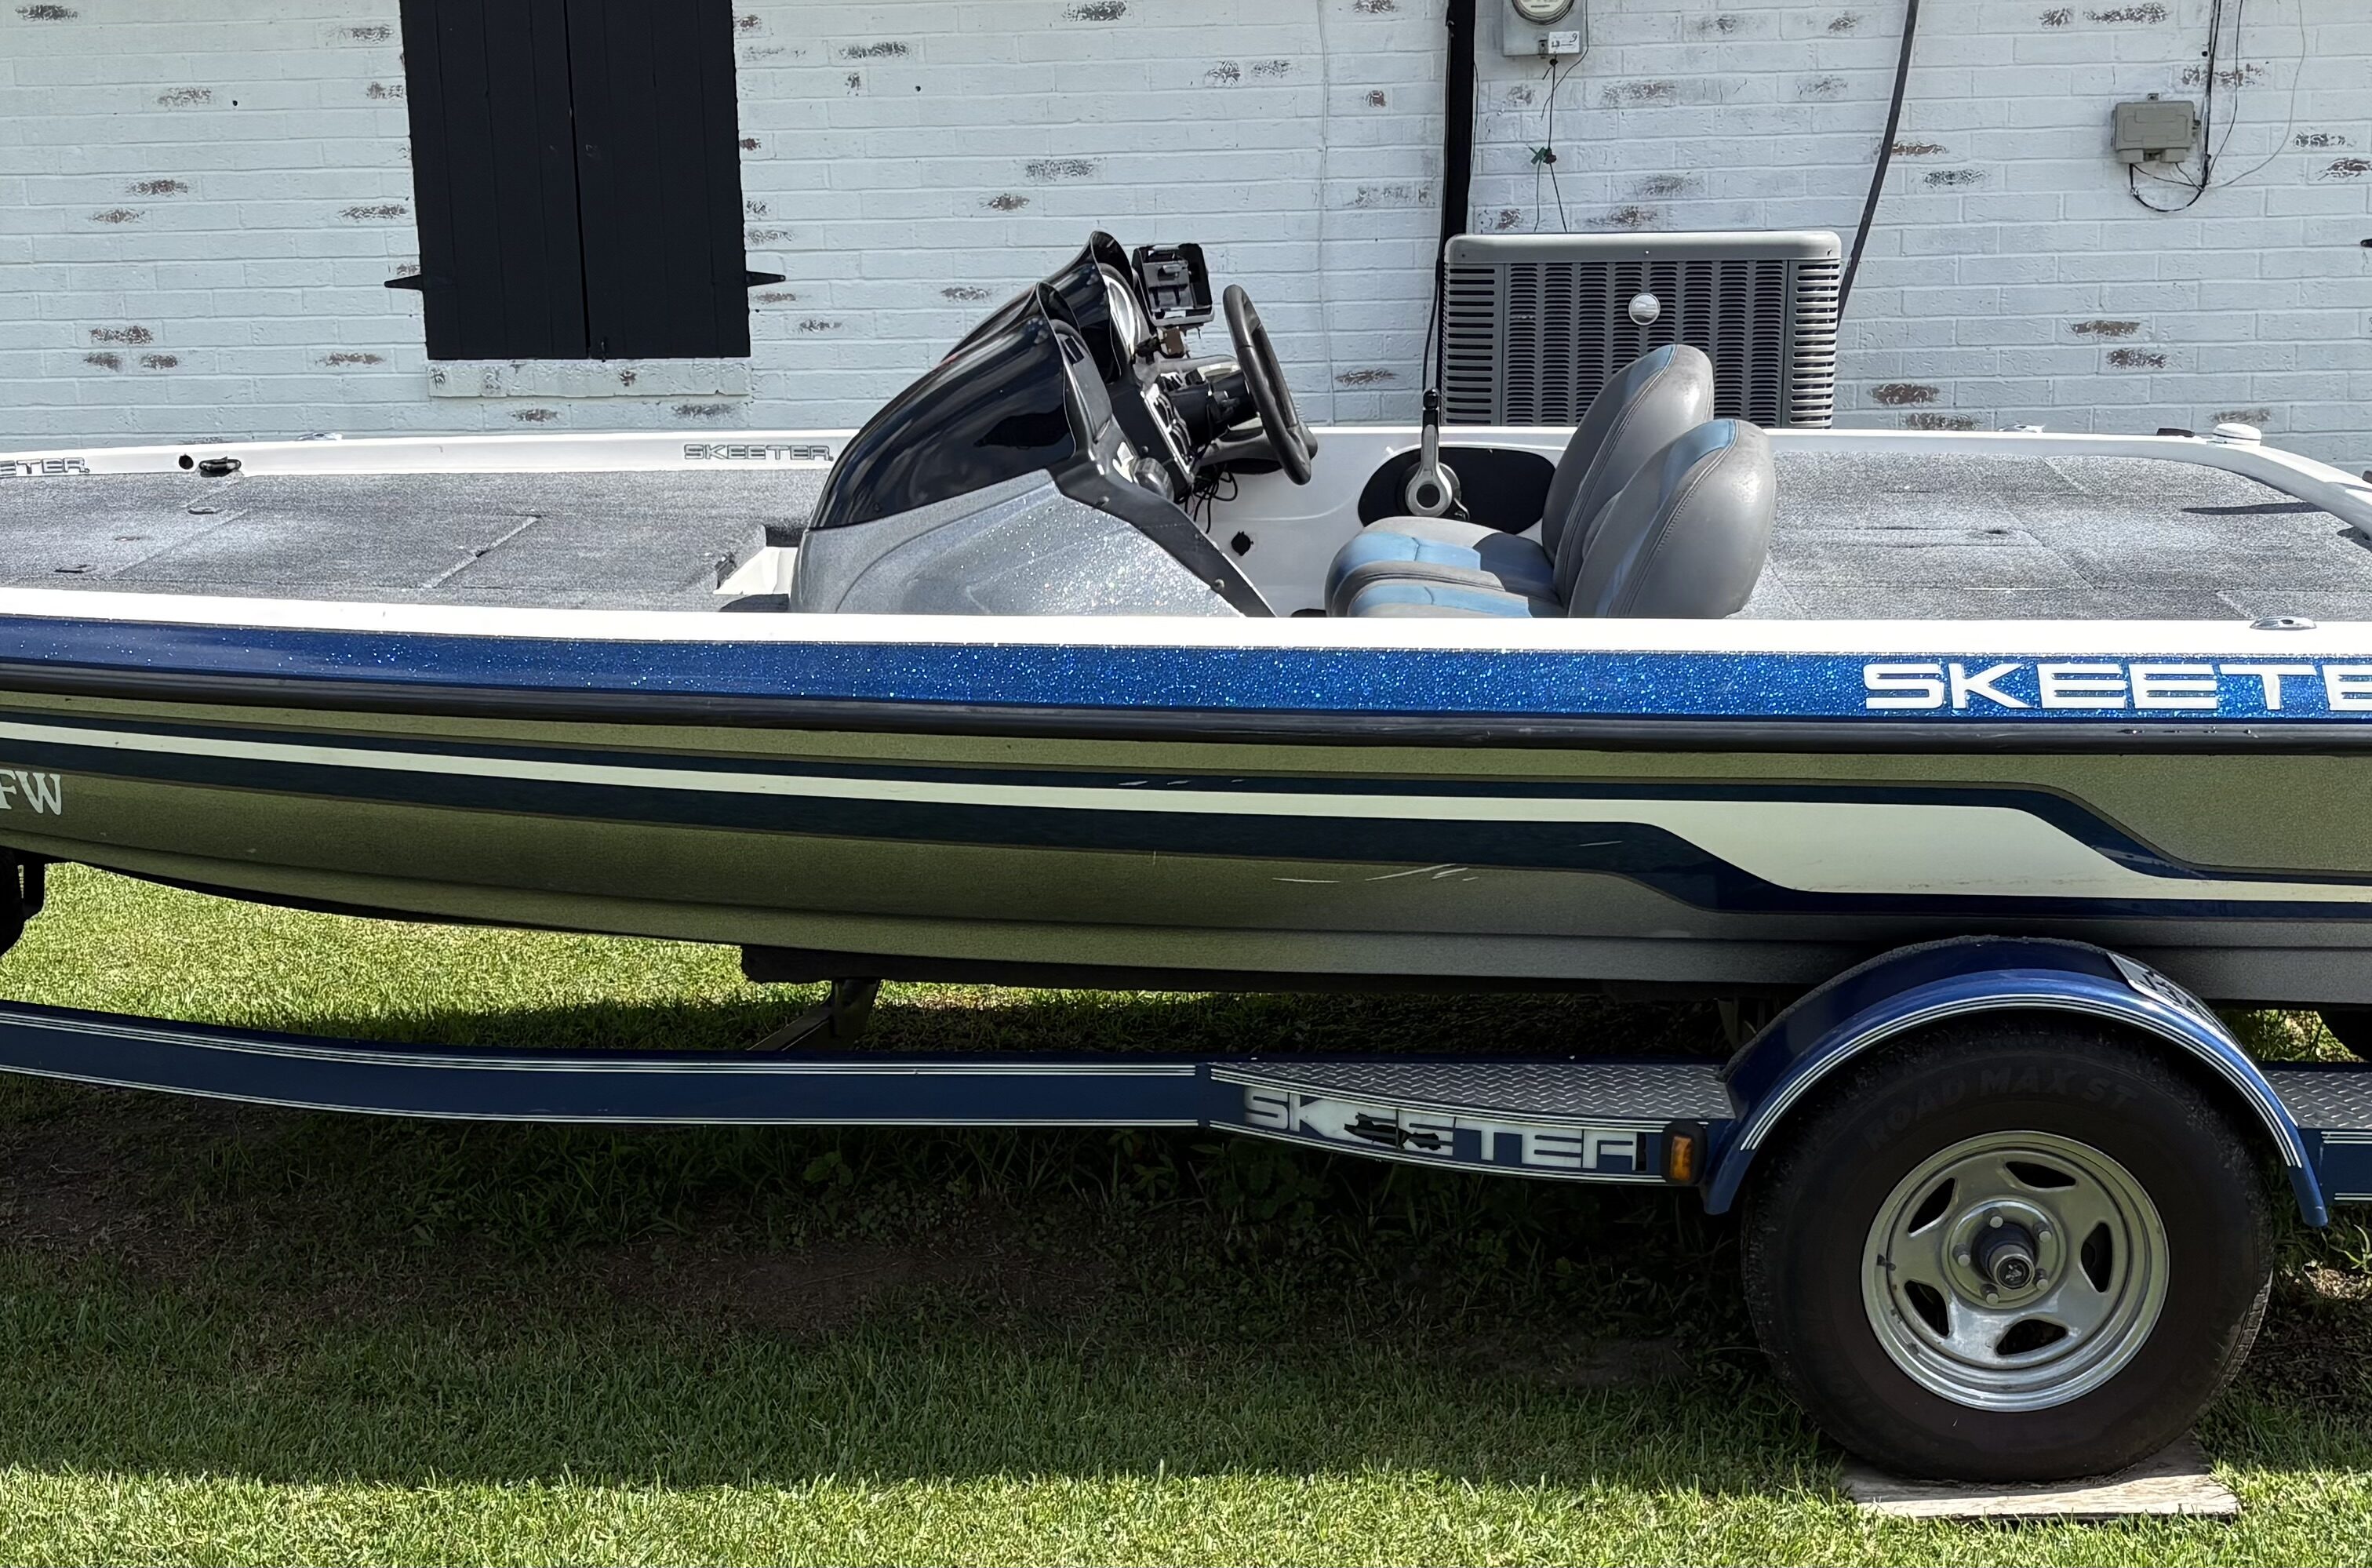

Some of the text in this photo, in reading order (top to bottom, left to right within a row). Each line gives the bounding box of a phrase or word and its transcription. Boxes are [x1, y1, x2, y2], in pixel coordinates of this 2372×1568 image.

[684, 444, 831, 461] SKEETER
[1863, 1065, 2143, 1152] ROAD MAX ST
